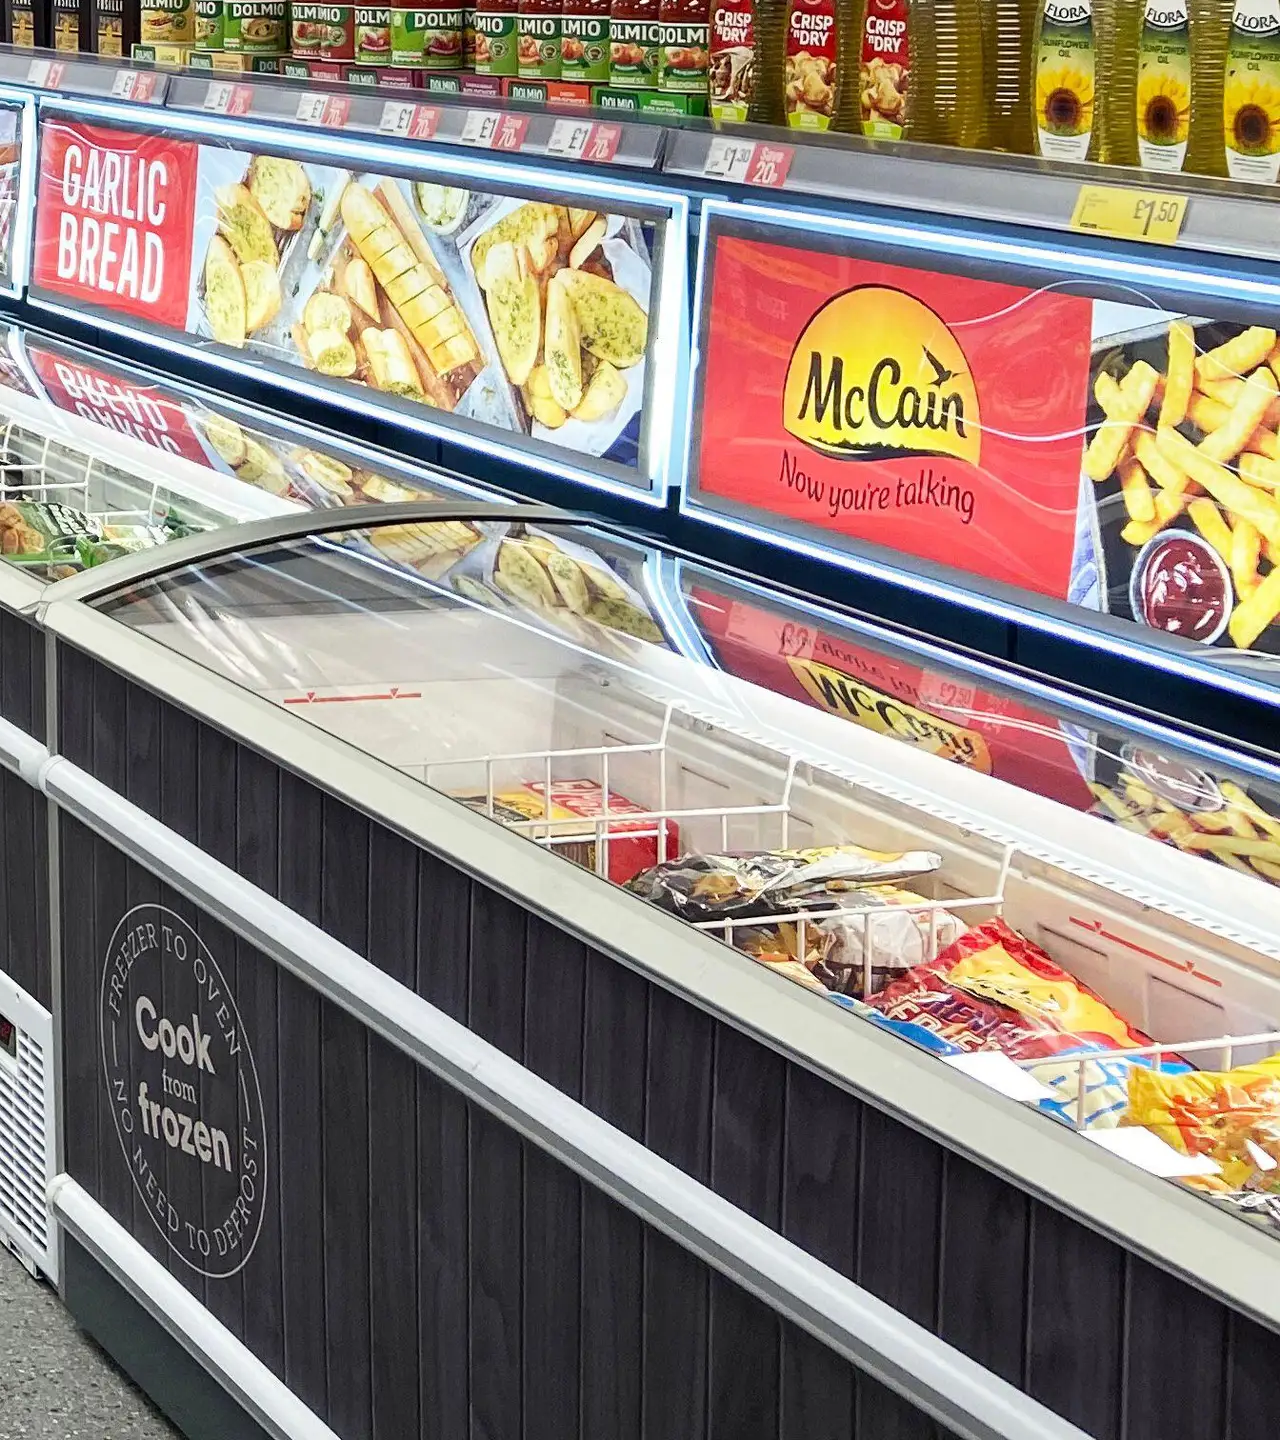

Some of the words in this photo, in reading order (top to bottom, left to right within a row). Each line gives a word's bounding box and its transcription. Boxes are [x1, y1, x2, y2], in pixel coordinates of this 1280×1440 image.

[232, 3, 284, 17] DOLMIO
[715, 9, 752, 29] CRISP
[790, 10, 834, 31] CRISP
[1045, 4, 1089, 21] FLORA
[1145, 8, 1185, 24] FLORA
[1234, 12, 1279, 28] FLORA
[865, 16, 906, 36] CRISP
[1042, 39, 1090, 49] SUNFLOWER
[1058, 48, 1072, 58] OIL
[1142, 44, 1186, 55] SUNFLOWER
[1157, 54, 1170, 64] OIL
[1247, 62, 1260, 71] OIL
[396, 109, 412, 129] £1
[479, 118, 495, 139] £1
[569, 127, 587, 149] £1
[760, 147, 783, 162] Save
[756, 160, 778, 185] 20p
[62, 144, 167, 226] GARLIC
[1134, 197, 1179, 236] £1.50
[56, 210, 165, 304] BREAD
[798, 349, 966, 439] McCain
[780, 449, 824, 502] Now
[828, 481, 890, 517] you're
[895, 470, 975, 525] talking
[109, 922, 159, 1018] FREEZER
[162, 926, 187, 961] TO
[192, 958, 241, 1056] OVEN
[135, 995, 216, 1075] Cook
[161, 1067, 197, 1105] from
[137, 1080, 233, 1173] frozen
[133, 1147, 180, 1233] NEED
[185, 1221, 211, 1257] TO
[214, 1127, 258, 1257] DEFROST
